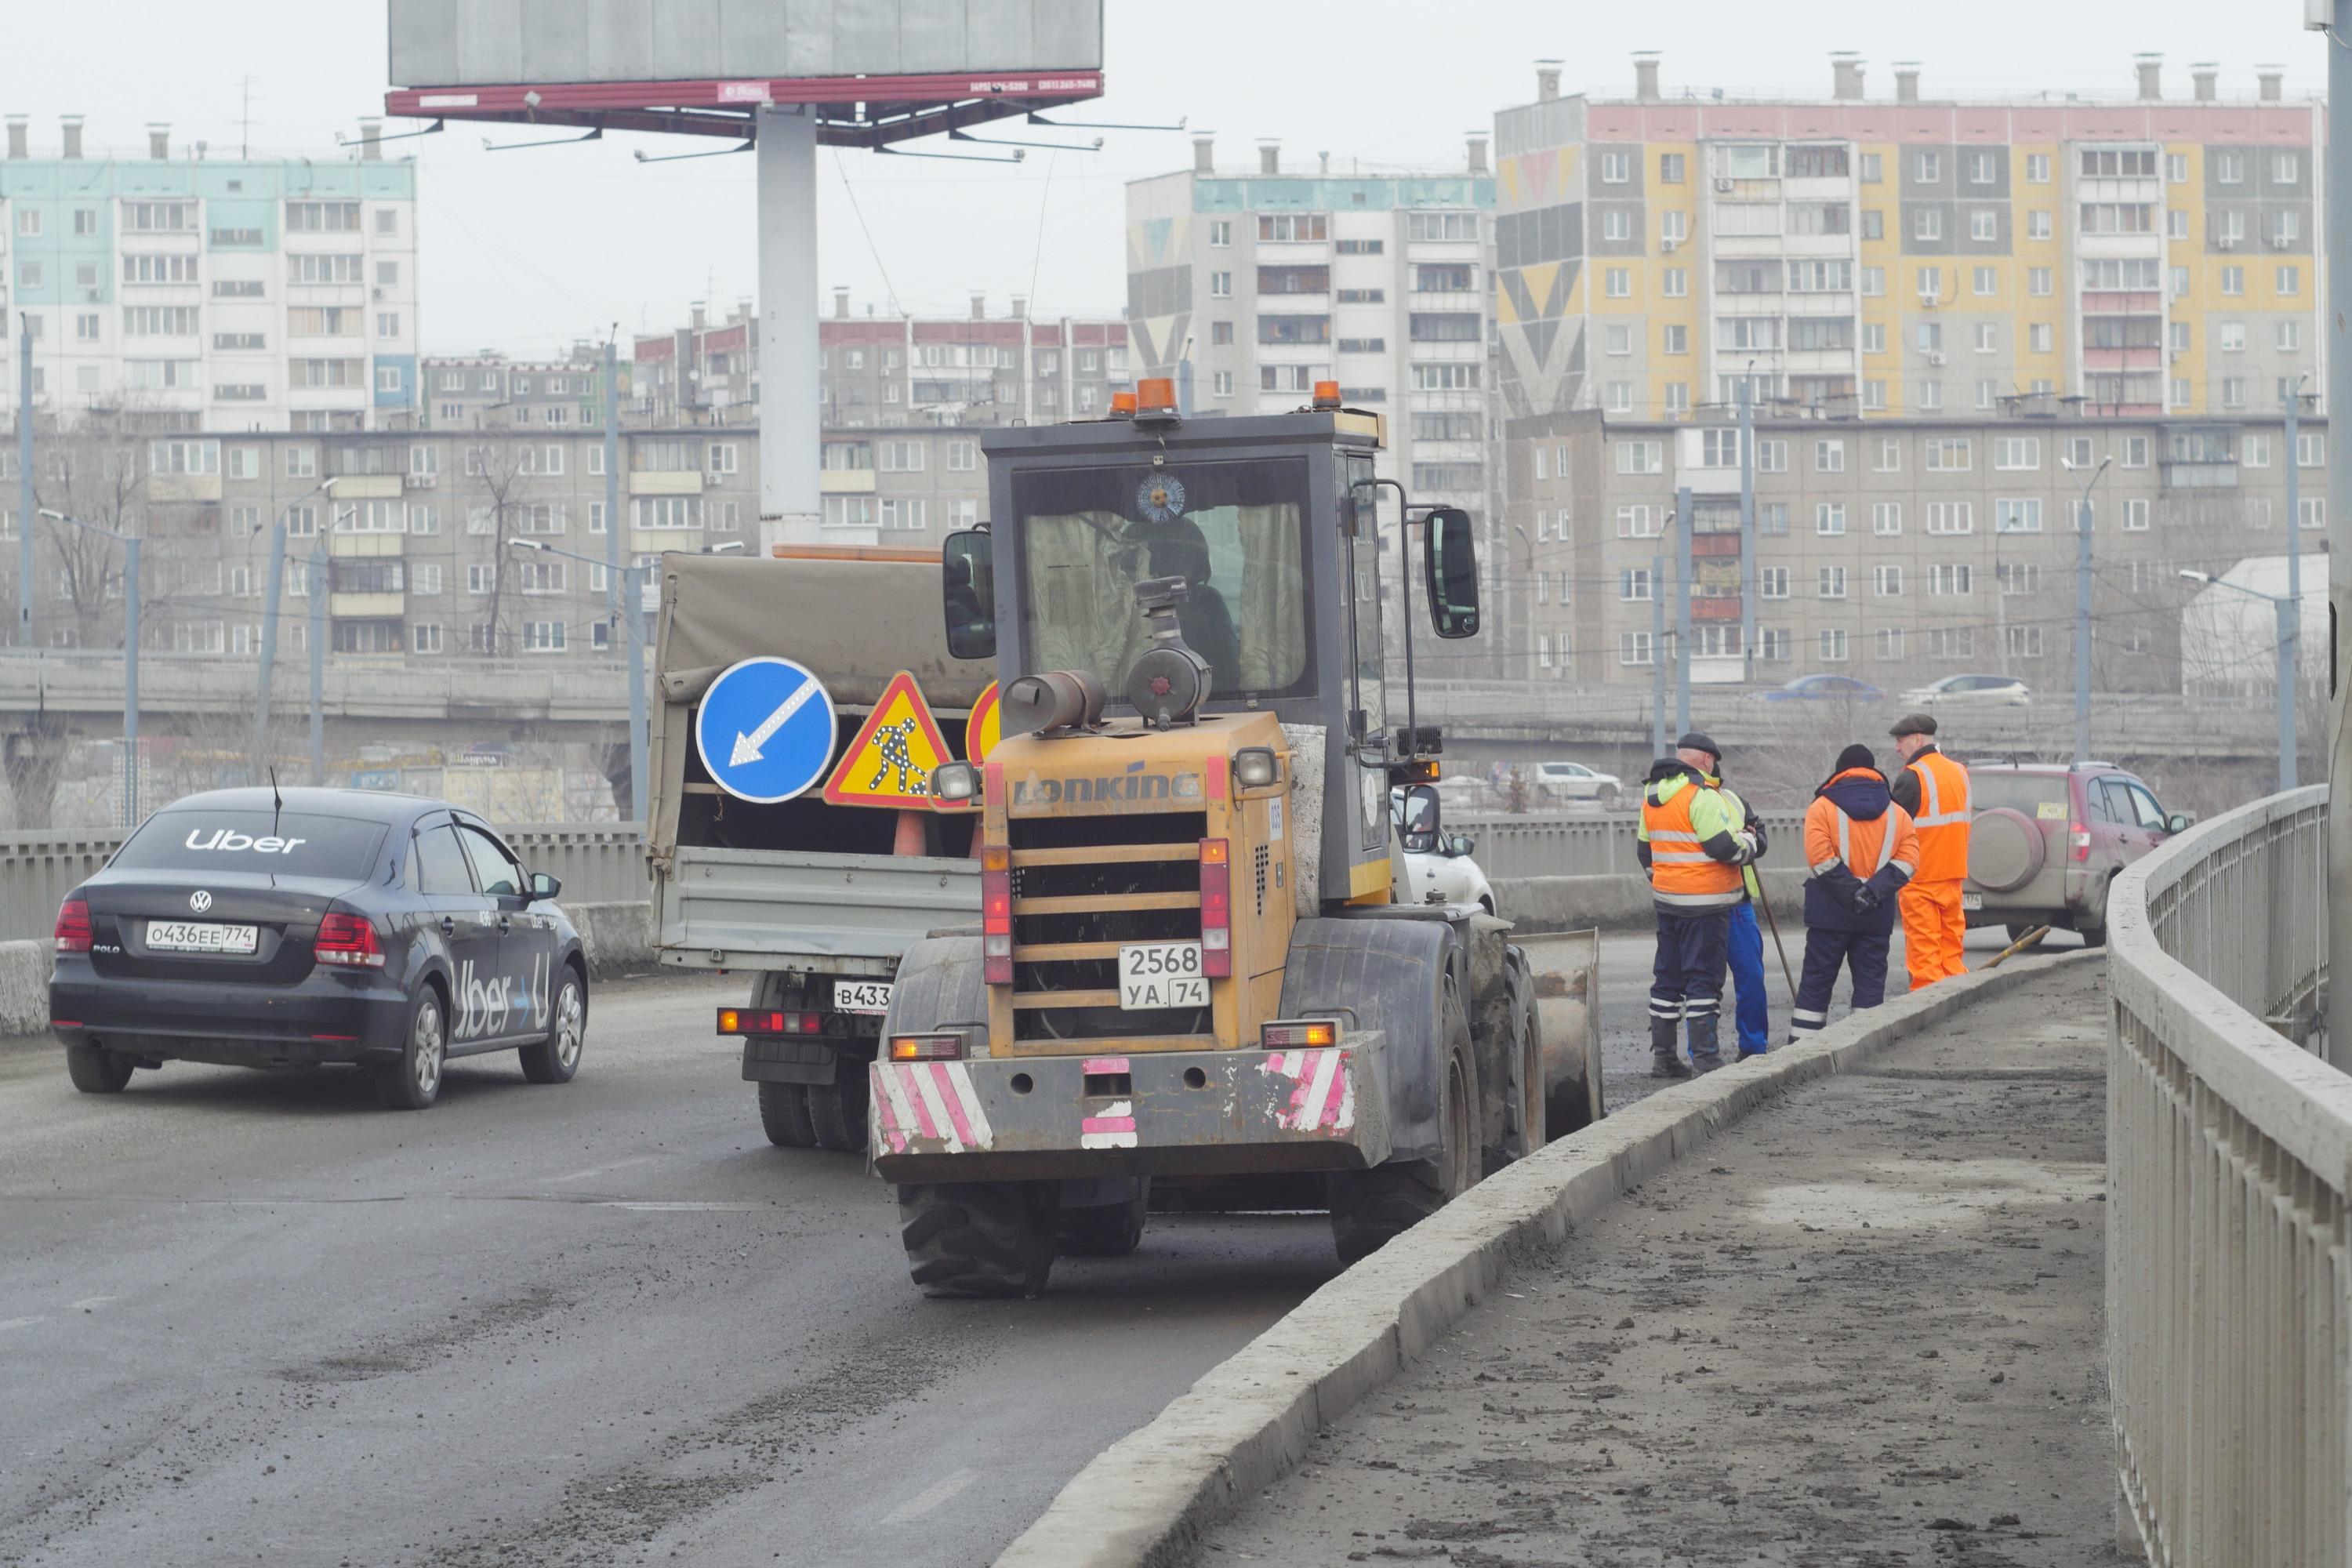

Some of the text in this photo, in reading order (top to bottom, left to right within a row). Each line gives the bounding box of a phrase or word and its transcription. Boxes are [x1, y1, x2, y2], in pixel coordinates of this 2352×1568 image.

[185, 829, 307, 855] Uber
[225, 927, 252, 942] 774
[93, 944, 120, 954] POLO
[1129, 947, 1198, 976] 2568
[1175, 982, 1203, 1003] 74
